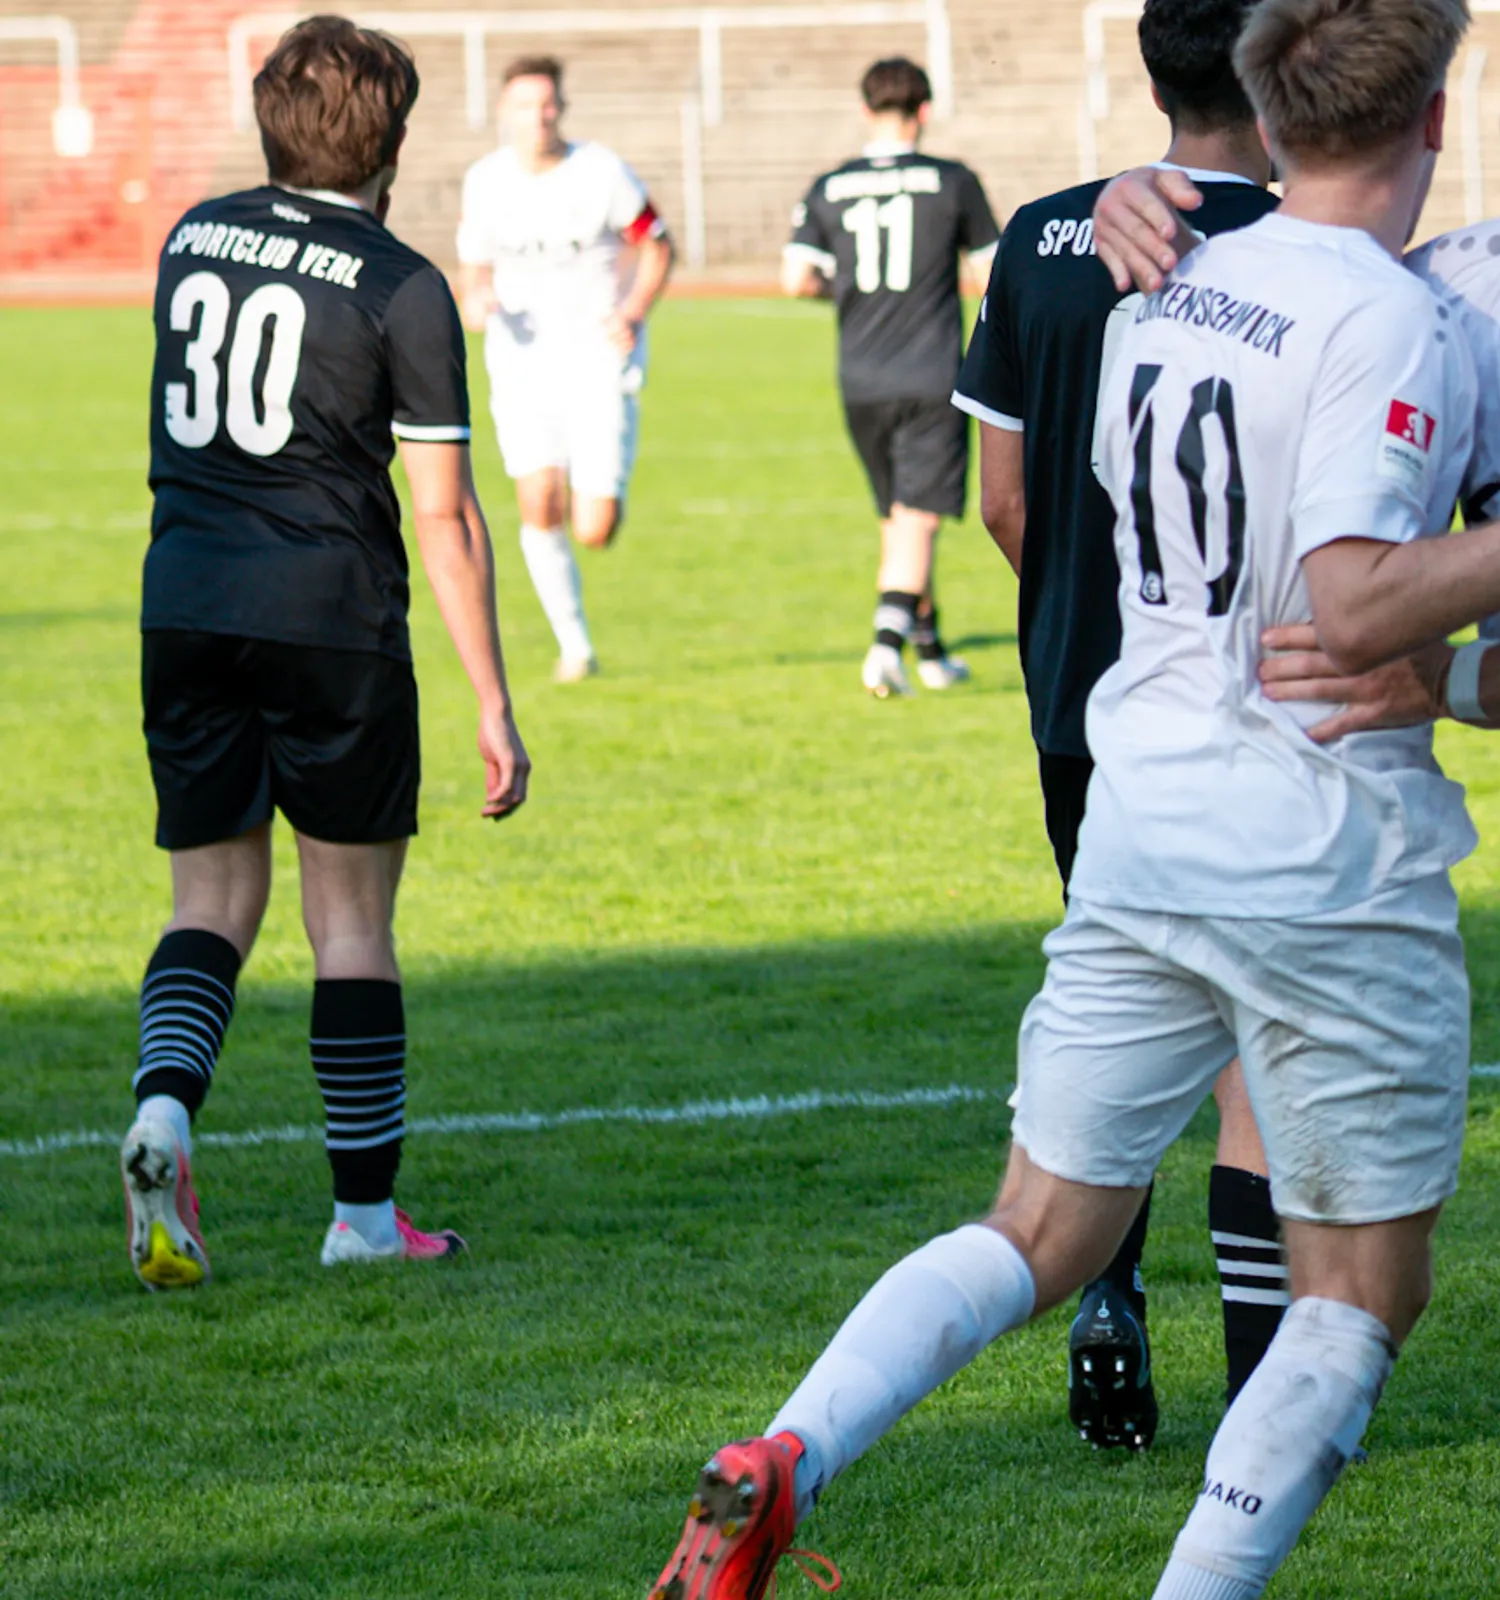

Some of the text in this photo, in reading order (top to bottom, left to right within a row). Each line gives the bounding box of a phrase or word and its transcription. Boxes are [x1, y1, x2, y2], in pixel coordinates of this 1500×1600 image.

[168, 221, 364, 289] SPORTCLUB VERL
[841, 193, 914, 293] 11
[164, 270, 307, 457] 30
[1128, 363, 1247, 618] 10
